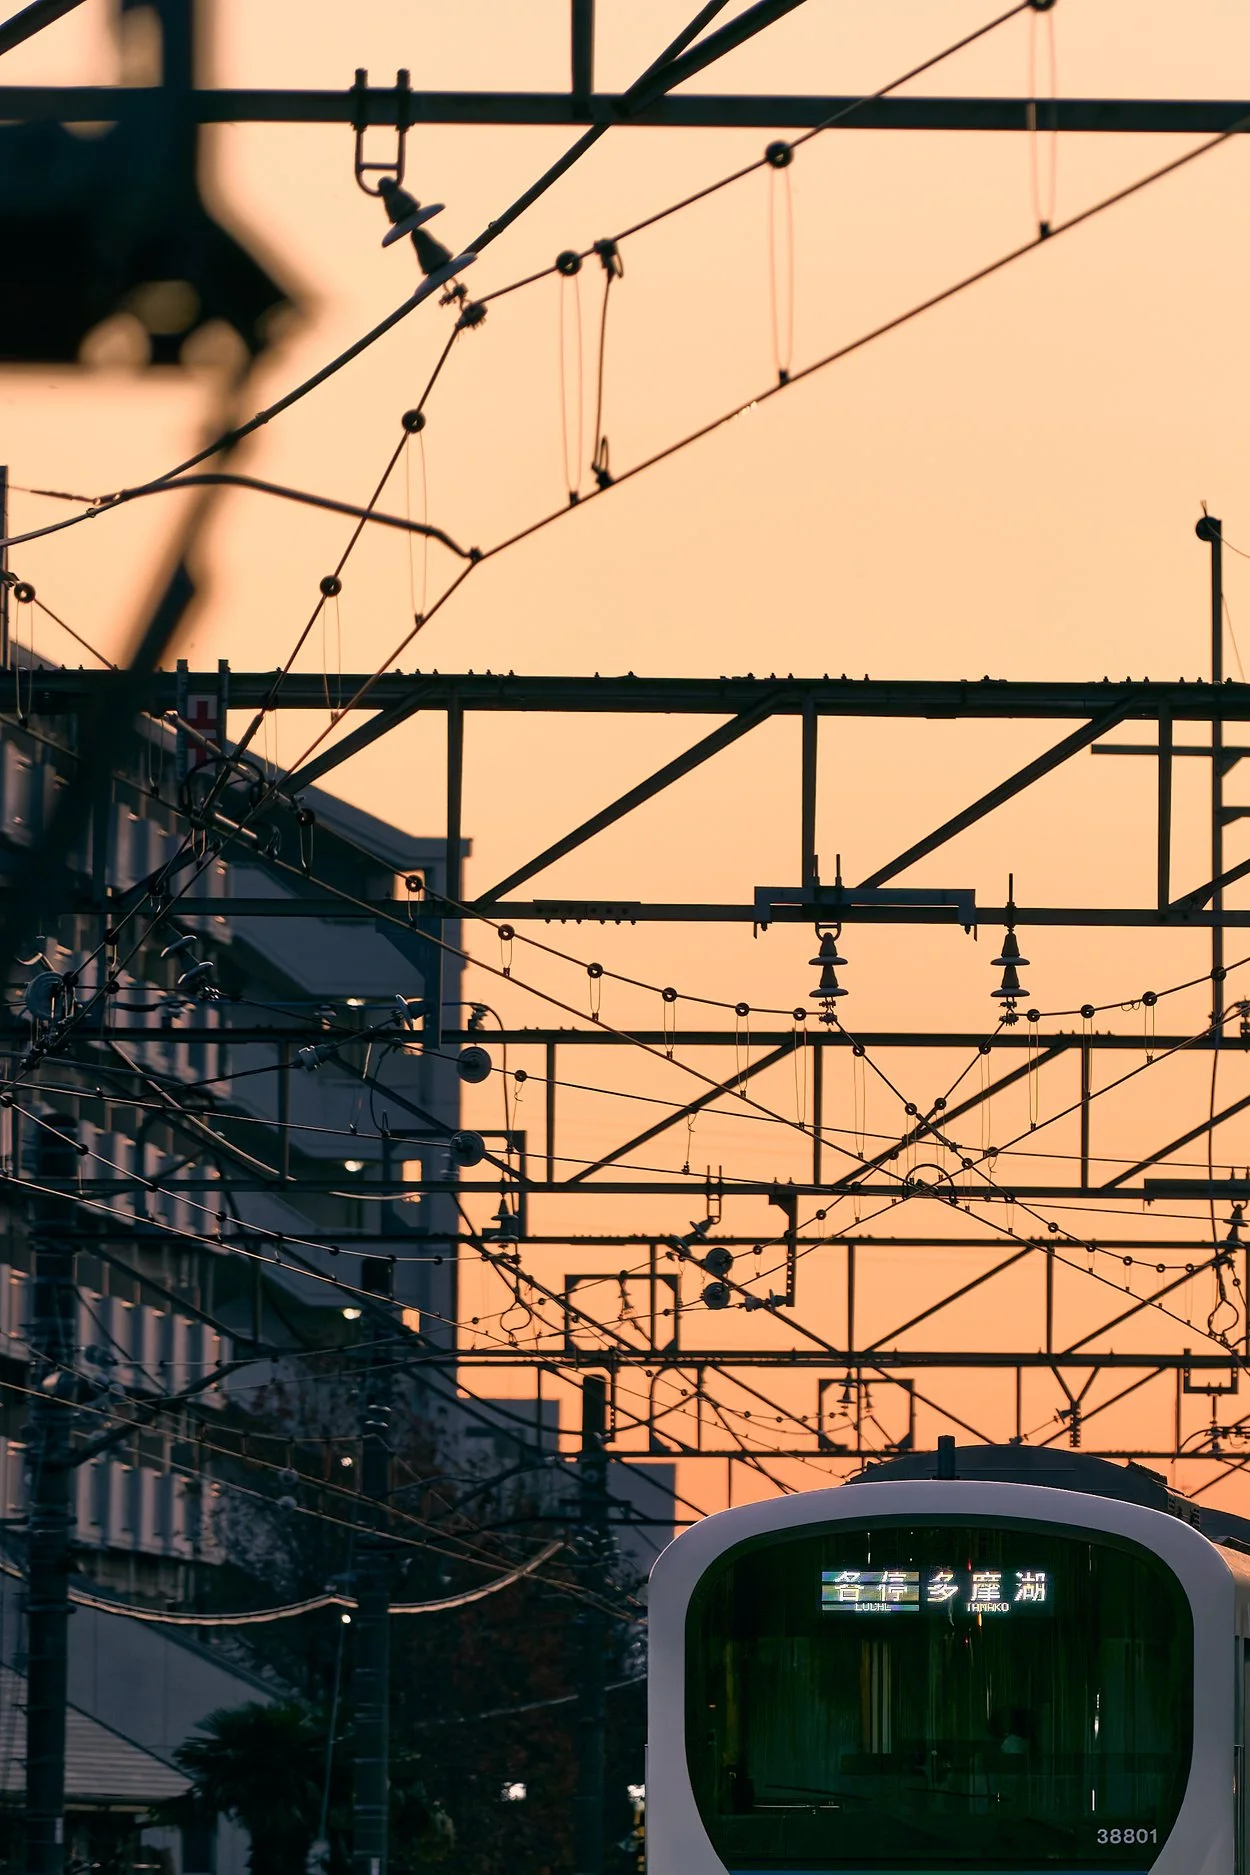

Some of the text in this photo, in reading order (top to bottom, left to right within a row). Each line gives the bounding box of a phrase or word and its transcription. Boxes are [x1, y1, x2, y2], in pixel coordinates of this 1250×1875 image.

[927, 1571, 1046, 1602] 多摩湖
[1096, 1828, 1158, 1844] 38801
